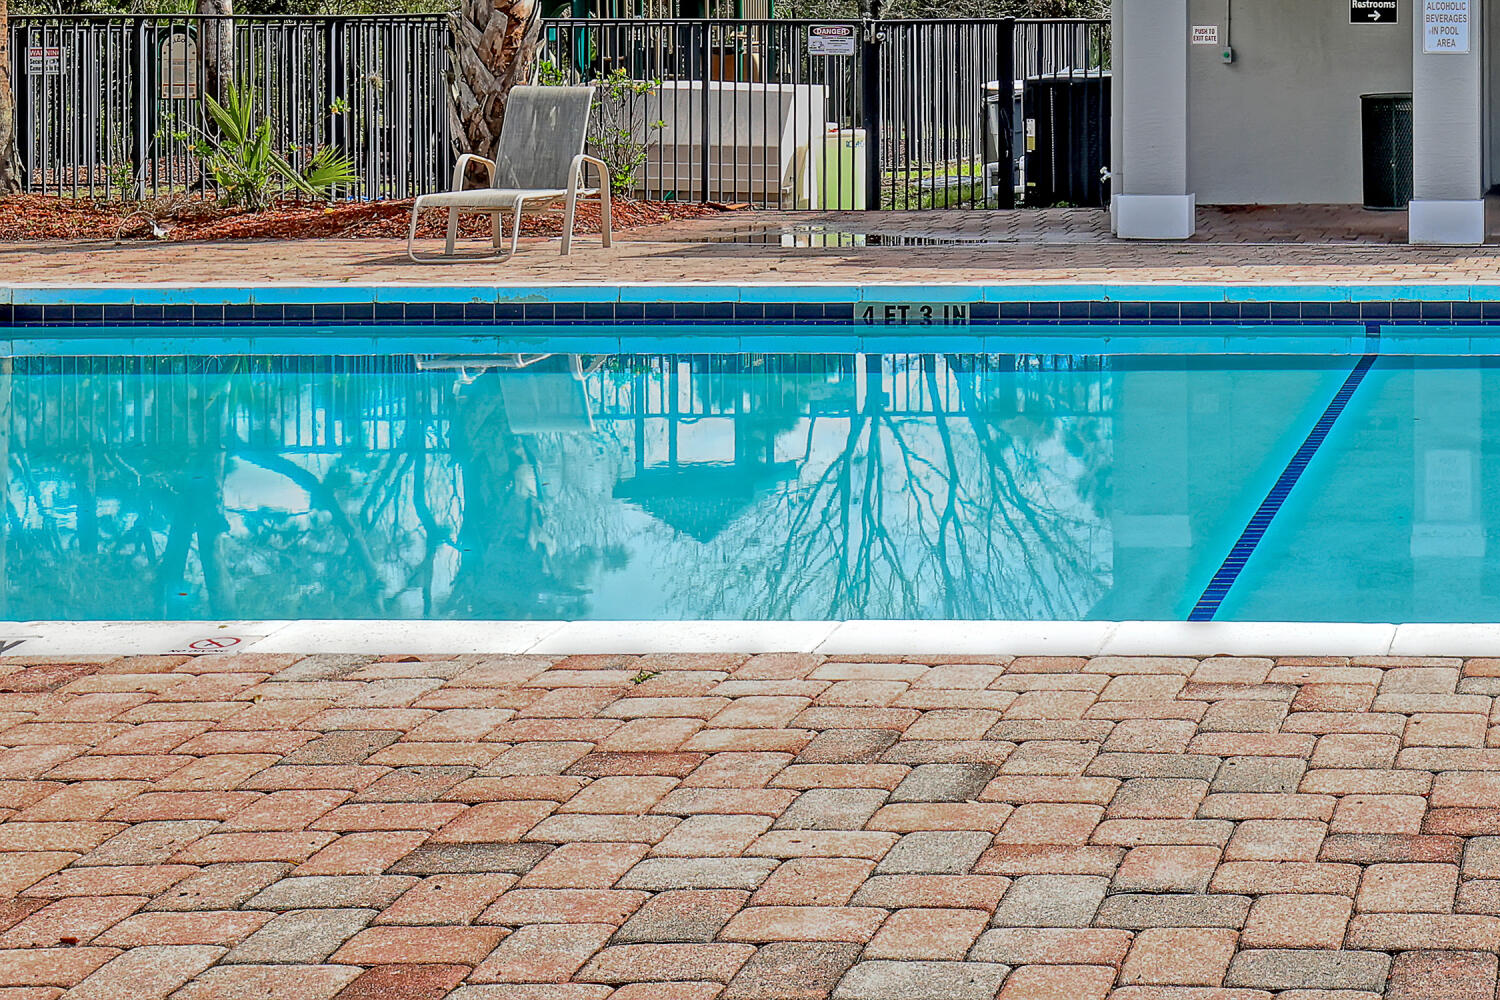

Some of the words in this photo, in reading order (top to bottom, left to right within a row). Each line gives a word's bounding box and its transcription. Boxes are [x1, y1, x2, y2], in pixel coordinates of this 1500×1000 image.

[1352, 0, 1396, 8] Restrooms
[1426, 2, 1466, 10] ALCOHOLIC
[1426, 14, 1467, 22] BEVERAGES
[1432, 26, 1438, 35] IN
[1441, 26, 1459, 35] POOL
[1437, 39, 1456, 47] AREA
[863, 305, 874, 320] 4
[885, 305, 910, 320] FT
[920, 305, 932, 320] 3
[944, 305, 966, 320] IN
